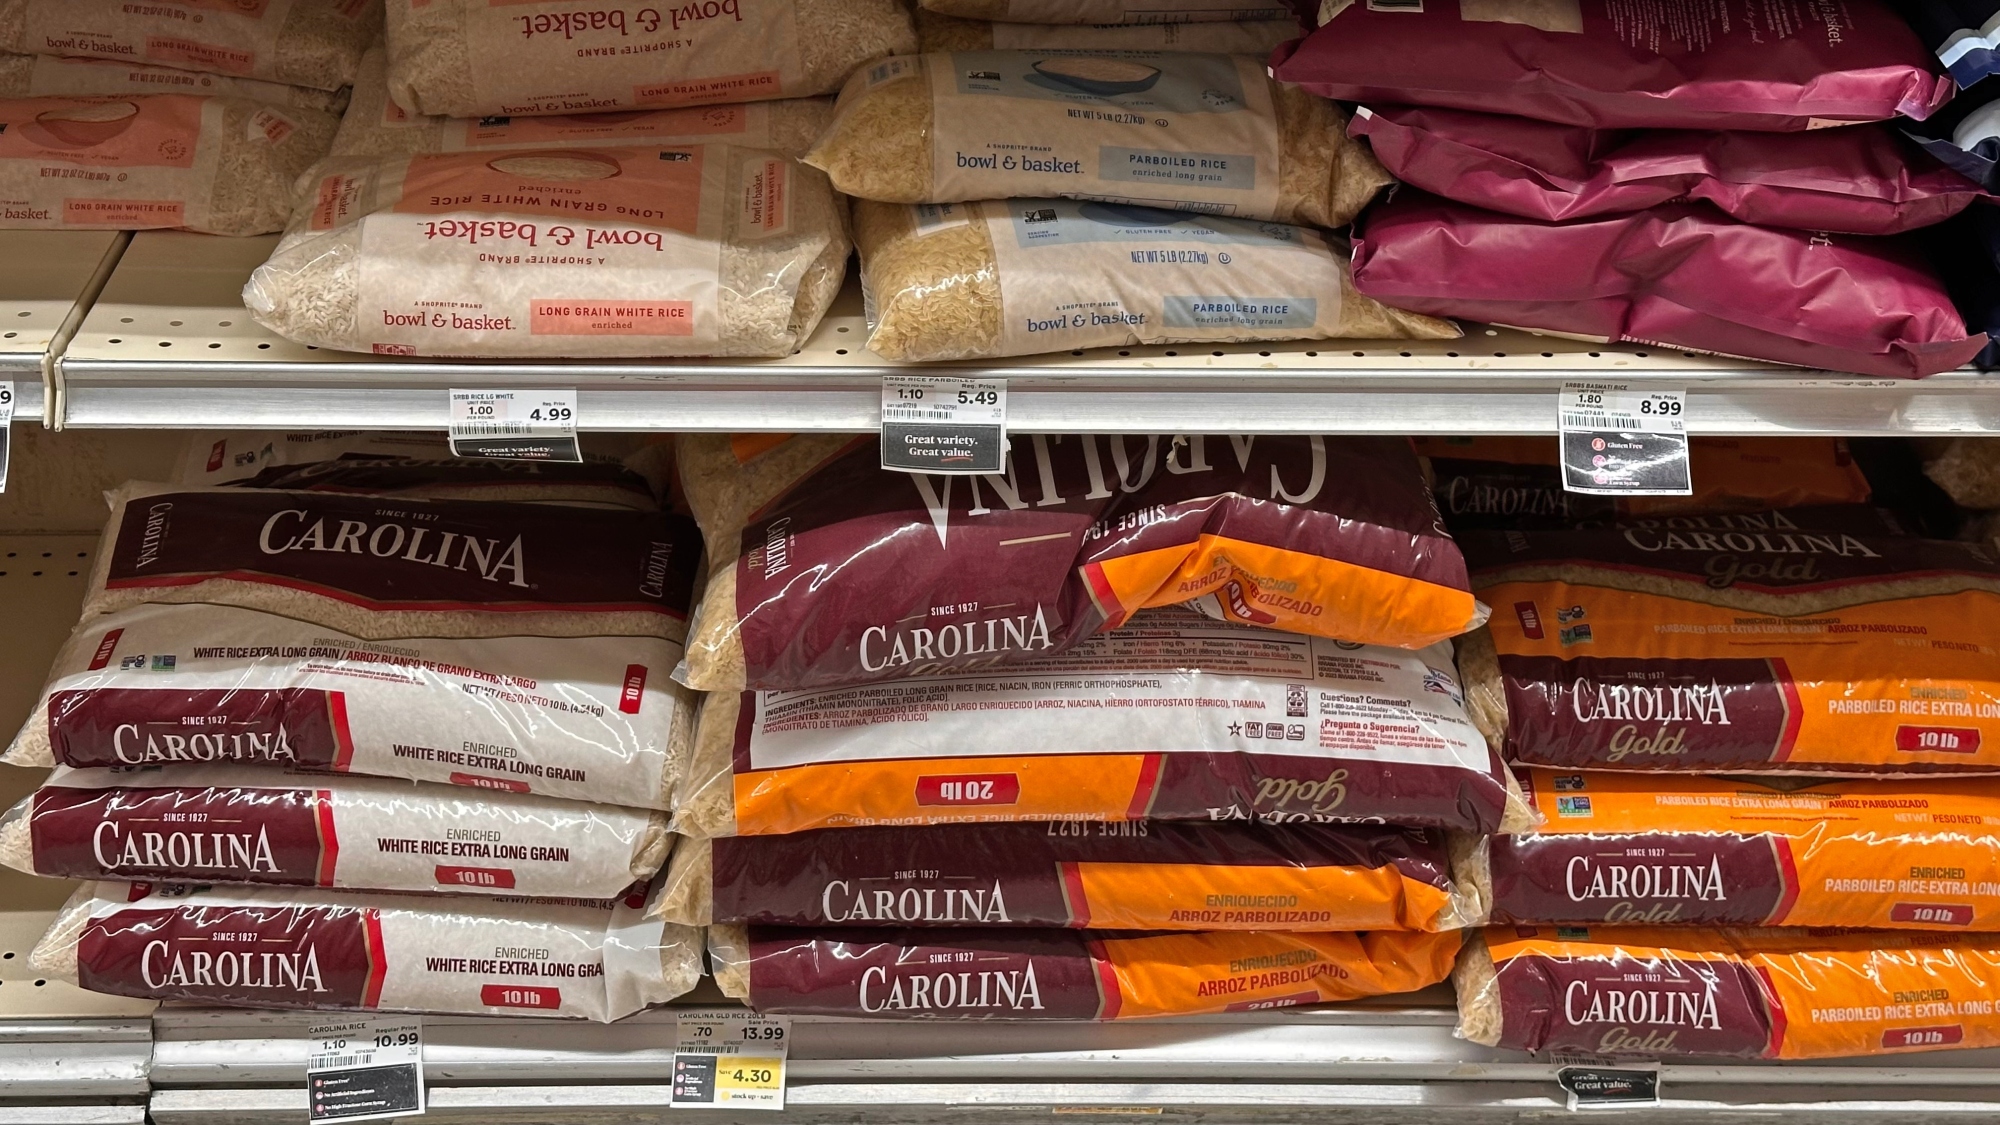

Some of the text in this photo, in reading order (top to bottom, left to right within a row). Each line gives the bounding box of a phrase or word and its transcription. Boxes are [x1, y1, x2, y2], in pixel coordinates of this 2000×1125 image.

[956, 152, 998, 170] bowl
[1002, 156, 1018, 171] &
[1129, 154, 1228, 170] PARBOILED RICE
[1132, 168, 1223, 183] enriched long grain
[69, 203, 92, 211] LONG
[125, 204, 154, 212] WHITE
[157, 205, 178, 213] RICE
[429, 194, 664, 219] LONG GRAIN WHITE RICE
[547, 223, 575, 246] &
[587, 228, 664, 252] bowl
[539, 306, 685, 318] LONG GRAIN WHITE RICE
[1193, 303, 1289, 315] PARBOILED RICE
[383, 310, 427, 328] bowl
[431, 314, 447, 328] &
[591, 320, 633, 331] enriched
[1027, 315, 1068, 332] bowl
[1071, 313, 1087, 328] &
[898, 389, 923, 399] 1.10
[957, 391, 998, 405] 5.49
[1578, 394, 1602, 404] 1.80
[468, 406, 493, 415] 1.00
[530, 408, 572, 421] 4.99
[1640, 400, 1681, 416] 8.99
[904, 434, 978, 447] Great variety.
[909, 447, 974, 457] Great value.
[259, 508, 530, 588] CAROLINA
[1623, 528, 1883, 559] CAROLINA
[931, 601, 979, 616] SINCE 1927
[859, 602, 1054, 673] CAROLINA
[1828, 624, 1928, 635] ARROZ PARBOLIZADO
[313, 637, 420, 658] ENRICHED ENRIQUECIDO
[193, 646, 226, 658] WHITE
[226, 646, 249, 658] RICE
[249, 647, 280, 658] EXTRA
[281, 647, 307, 659] LONG
[308, 647, 340, 660] GRAIN
[346, 651, 379, 664] ARROZ
[423, 659, 436, 672] DE
[437, 661, 472, 677] GRANO
[473, 669, 503, 684] EXTRA
[504, 673, 537, 690] LARGO
[1320, 692, 1411, 708] Questions? Comments?
[1573, 676, 1731, 725] CAROLINA
[1910, 687, 1967, 700] ENRICHED
[1828, 700, 2000, 719] PARBOILED RICE EXTRA LON
[182, 715, 228, 726] SINCE 1927
[112, 721, 297, 765] CAROLINA
[1606, 724, 1684, 763] Gold
[1918, 732, 1960, 749] 10 lb
[463, 741, 518, 759] ENRICHED
[393, 744, 586, 782] WHITE RICE EXTRA LONG GRAIN
[940, 781, 995, 800] 20 lb
[1655, 795, 1930, 810] PARBOILED RICE EXTRA LONG GRAIN ARROZ PARBOLIZADO
[163, 812, 209, 824] SINCE 1927
[1932, 814, 1983, 826] PESO NETO
[446, 827, 501, 843] ENRICHED
[93, 820, 281, 873] CAROLINA
[377, 838, 570, 862] WHITE RICE EXTRA LONG GRAIN
[1626, 848, 1666, 857] SINCE 1927
[455, 870, 496, 886] 10 lb
[894, 869, 940, 880] SINCE 1927
[1566, 853, 1727, 902] CAROLINA
[1909, 866, 1966, 880] ENRICHED
[821, 878, 1013, 923] CAROLINA
[1205, 893, 1298, 908] ENRIQUECIDO
[1168, 909, 1332, 924] ARROZ PARBOLIZADO
[1912, 907, 1954, 922] 10 lb
[213, 931, 258, 942] SINCE 1927
[495, 946, 549, 960] ENRICHED
[930, 952, 975, 964] SINCE 1927
[141, 939, 329, 993] CAROLINA
[426, 957, 467, 973] WHITE
[469, 959, 497, 975] RICE
[499, 960, 539, 976] EXTRA
[541, 962, 575, 978] LONG
[1229, 949, 1318, 974] ENRIQUECIDO
[859, 958, 1046, 1013] CAROLINA
[1196, 962, 1350, 997] ARROZ PARBOLIZADO
[501, 989, 542, 1006] 10 lb
[1893, 988, 1950, 1004] ENRICHED
[1564, 980, 1723, 1031] CAROLINA
[1811, 1000, 1992, 1024] PARBOILED RICE EXTRA LONG
[308, 1022, 367, 1034] CAROLINA RICE
[693, 1027, 712, 1036] .70
[741, 1027, 784, 1040] 13.99
[322, 1039, 347, 1050] 1.10
[373, 1032, 419, 1048] 10.99
[1596, 1026, 1678, 1054] Gold
[733, 1069, 772, 1083] 4.30
[1574, 1080, 1632, 1090] Great value.
